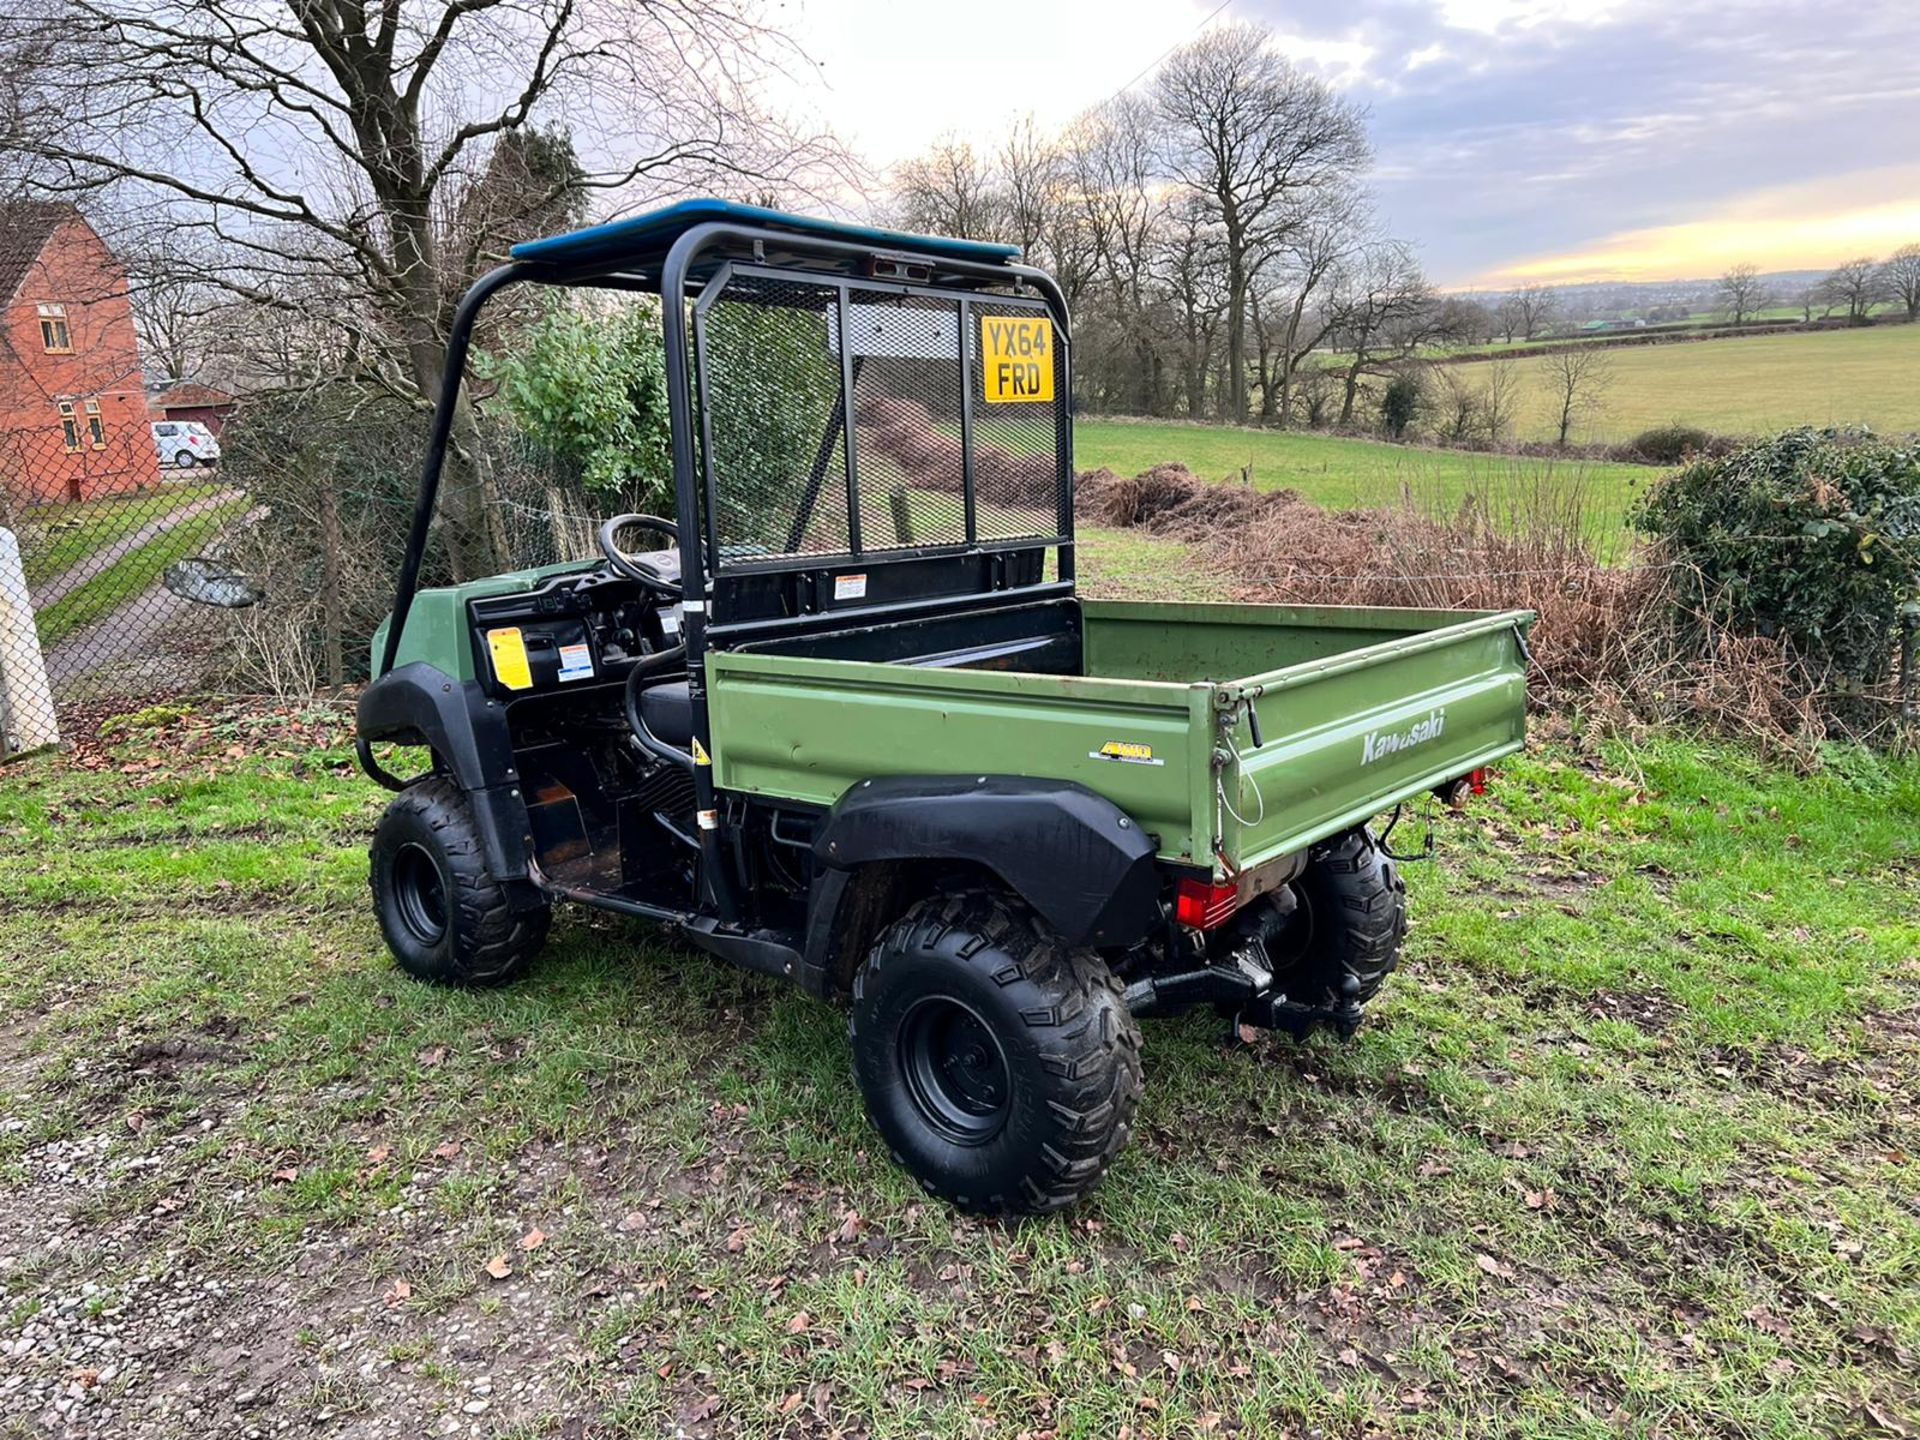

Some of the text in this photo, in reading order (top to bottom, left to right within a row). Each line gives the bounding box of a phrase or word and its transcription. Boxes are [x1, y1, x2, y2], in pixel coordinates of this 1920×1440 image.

[988, 322, 1046, 356] YX64
[998, 363, 1040, 395] FRD
[1360, 707, 1445, 766] Kawasaki
